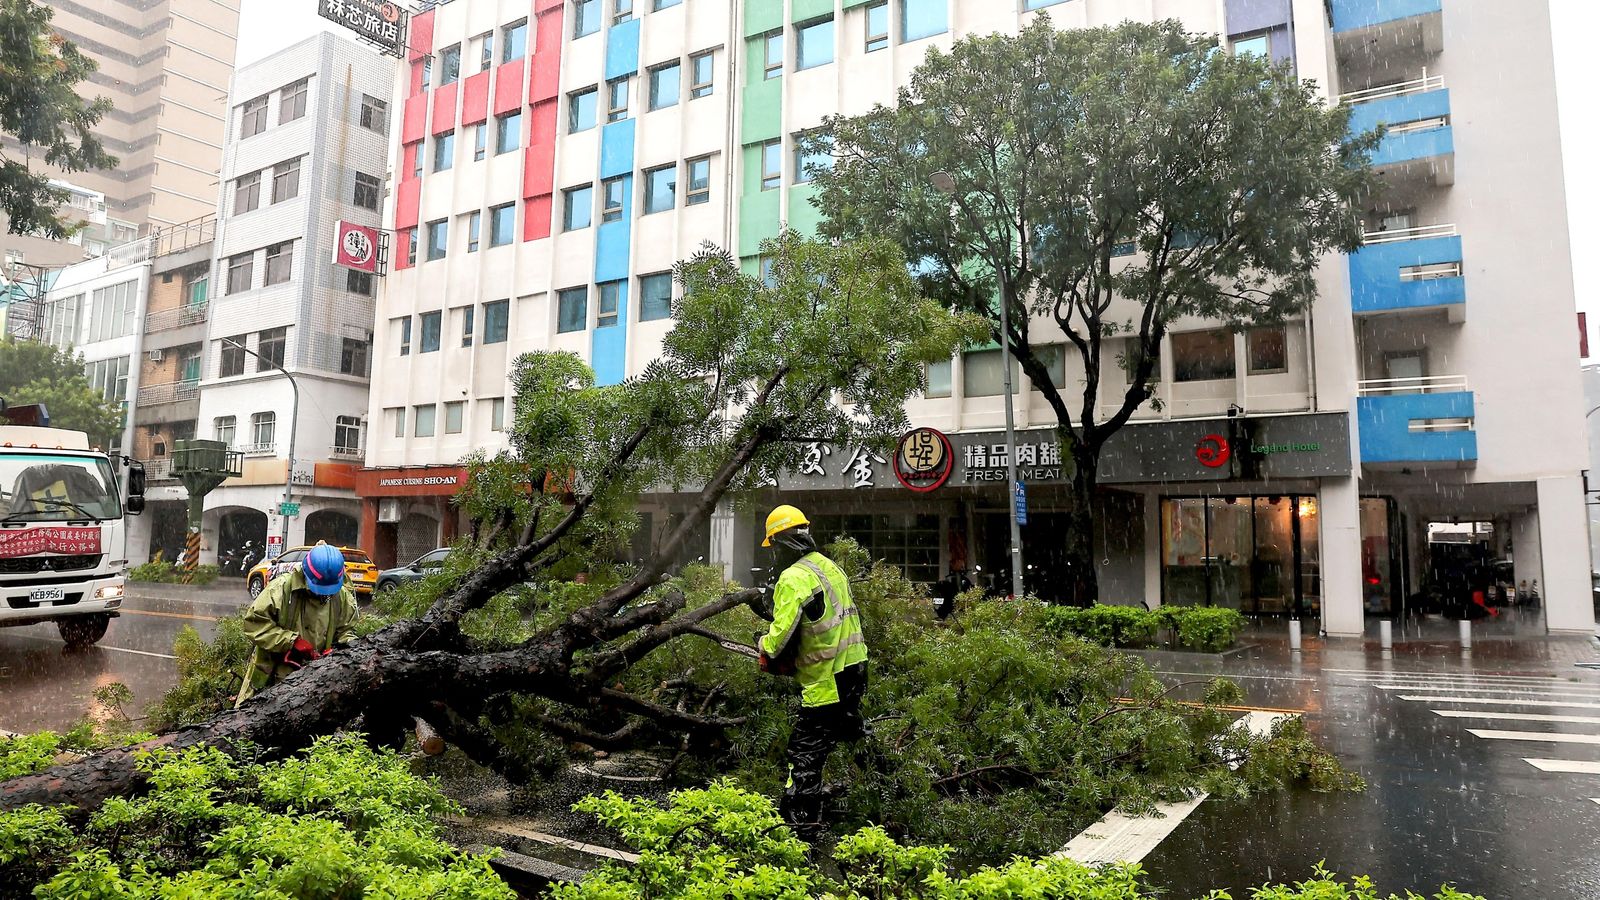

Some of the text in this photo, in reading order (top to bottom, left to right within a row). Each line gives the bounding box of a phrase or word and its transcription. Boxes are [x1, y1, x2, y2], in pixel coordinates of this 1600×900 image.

[1250, 441, 1321, 454] Legend Hotel
[1021, 468, 1060, 480] MEAT
[380, 476, 457, 486] JAPANESE CUISINE SHO-AN
